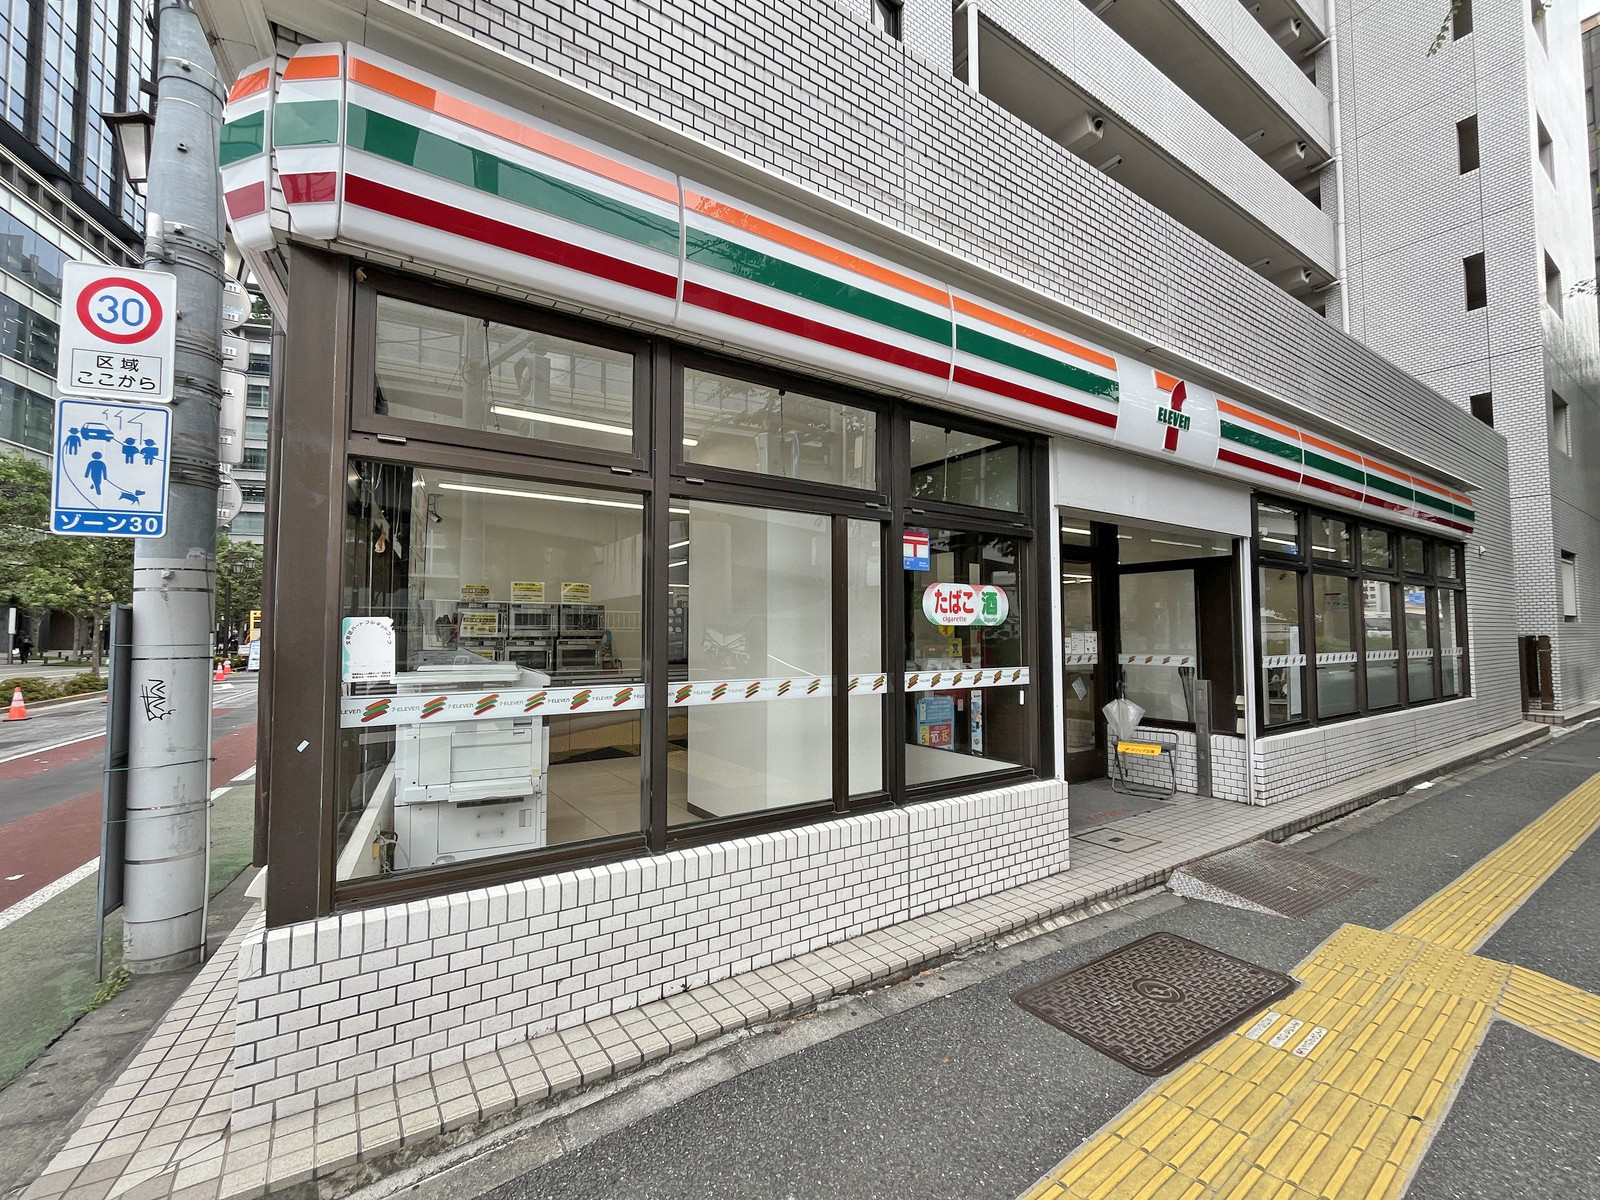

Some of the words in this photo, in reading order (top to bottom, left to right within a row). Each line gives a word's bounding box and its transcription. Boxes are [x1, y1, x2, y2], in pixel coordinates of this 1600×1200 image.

[96, 294, 145, 327] 30
[96, 355, 140, 373] 区域
[77, 370, 156, 391] ここから
[60, 513, 159, 533] ゾーン30
[981, 591, 998, 615] 酒
[942, 615, 967, 624] cigarette
